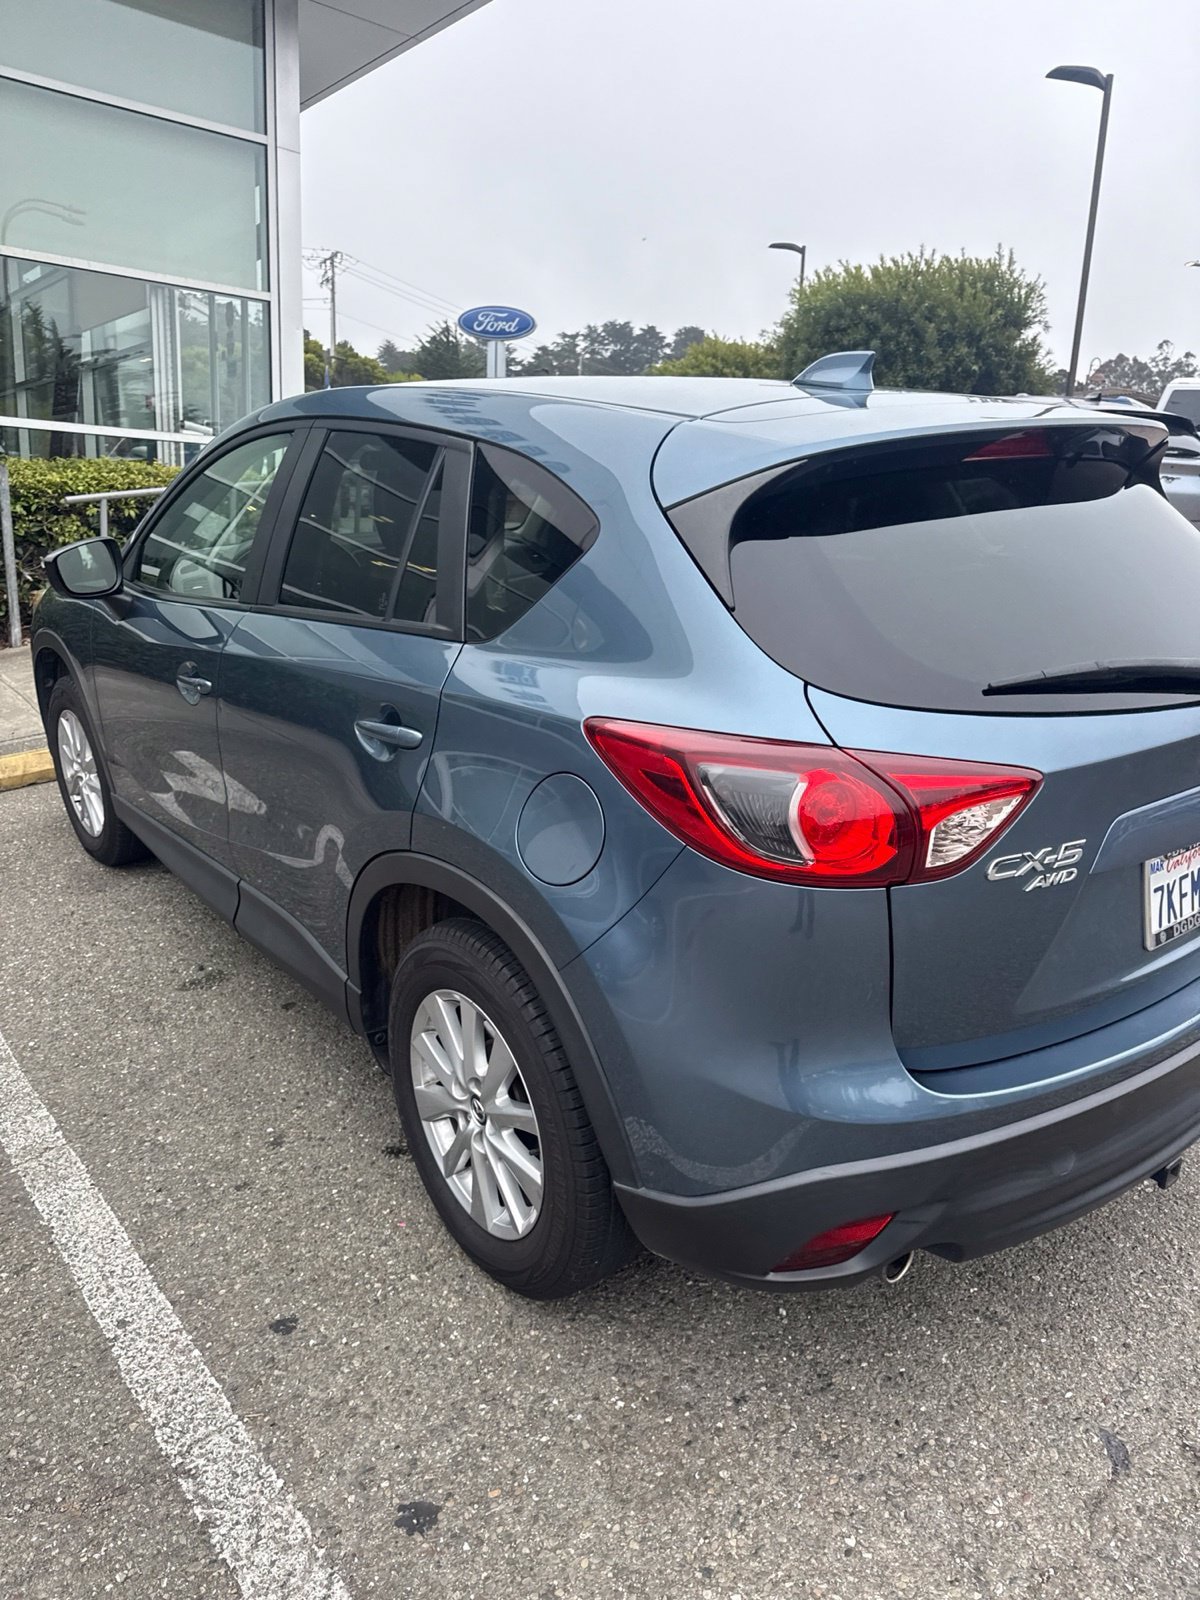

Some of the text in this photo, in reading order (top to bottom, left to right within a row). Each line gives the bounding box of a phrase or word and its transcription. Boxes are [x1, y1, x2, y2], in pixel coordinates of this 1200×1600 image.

[473, 311, 520, 332] Ford
[985, 838, 1086, 881] CX-5
[1022, 867, 1078, 892] AWD
[1153, 867, 1200, 929] 7KFM
